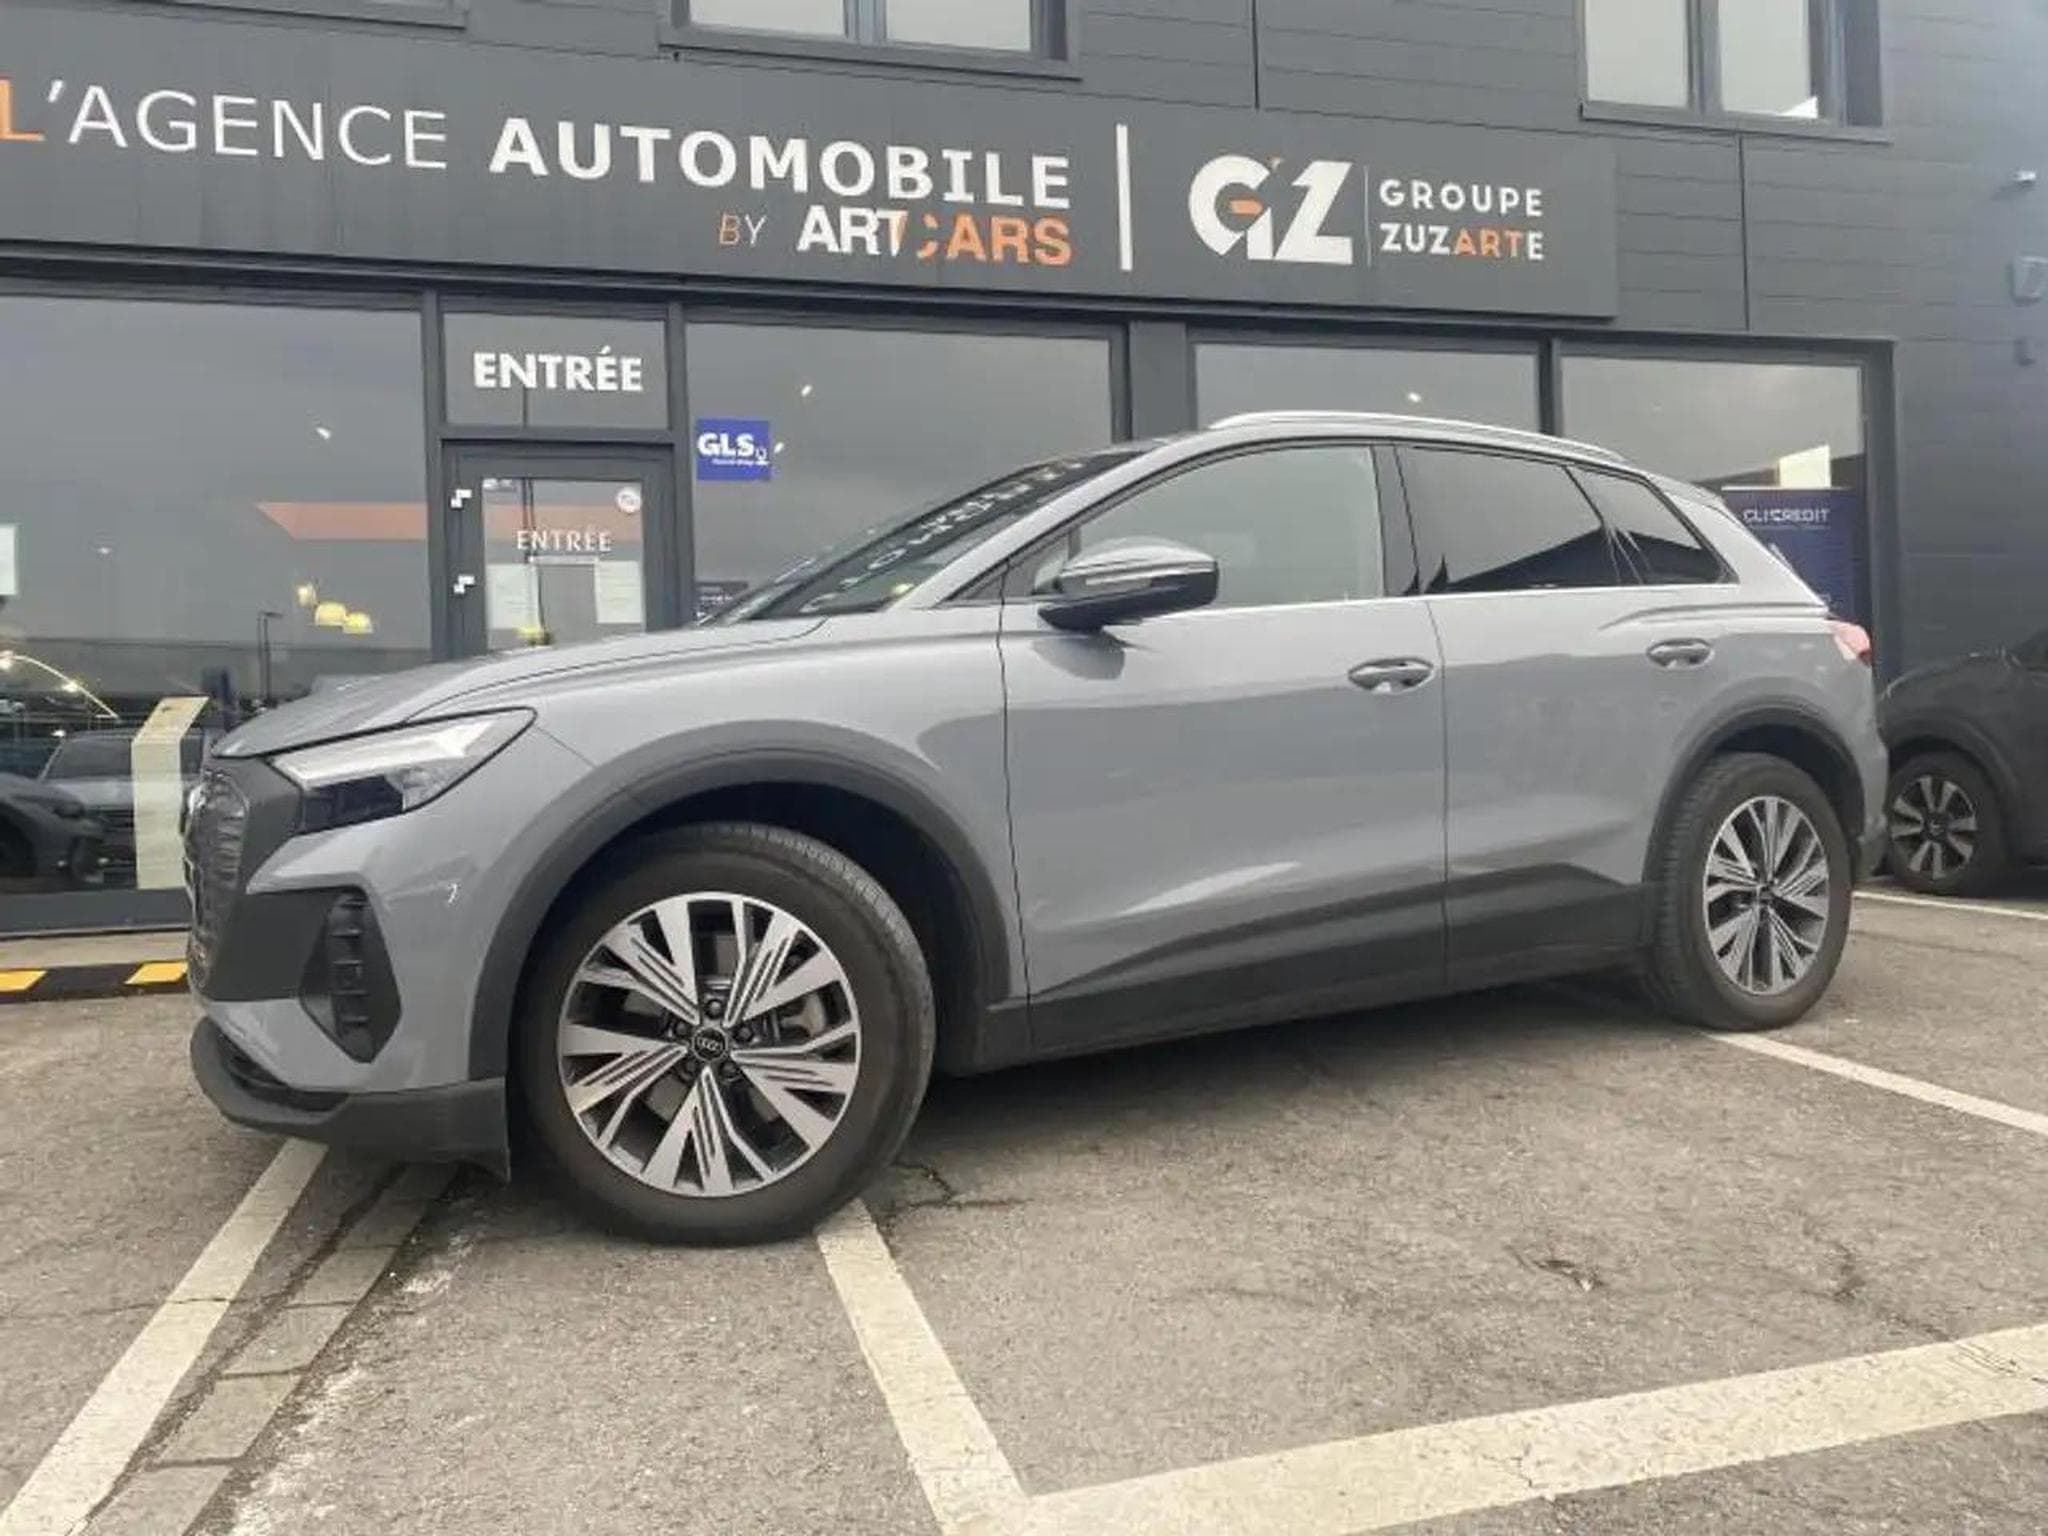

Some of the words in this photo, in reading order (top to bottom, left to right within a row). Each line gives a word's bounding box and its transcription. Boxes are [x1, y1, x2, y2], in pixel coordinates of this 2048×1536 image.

[0, 79, 448, 170] L'AGENCE
[489, 116, 1071, 210] AUTOMOBILE
[1379, 178, 1544, 218] GROUPE
[719, 211, 767, 247] BY
[1379, 222, 1545, 261] ZUZARTE
[473, 345, 644, 393] ENTRÉE
[516, 524, 613, 552] ENTRÉE
